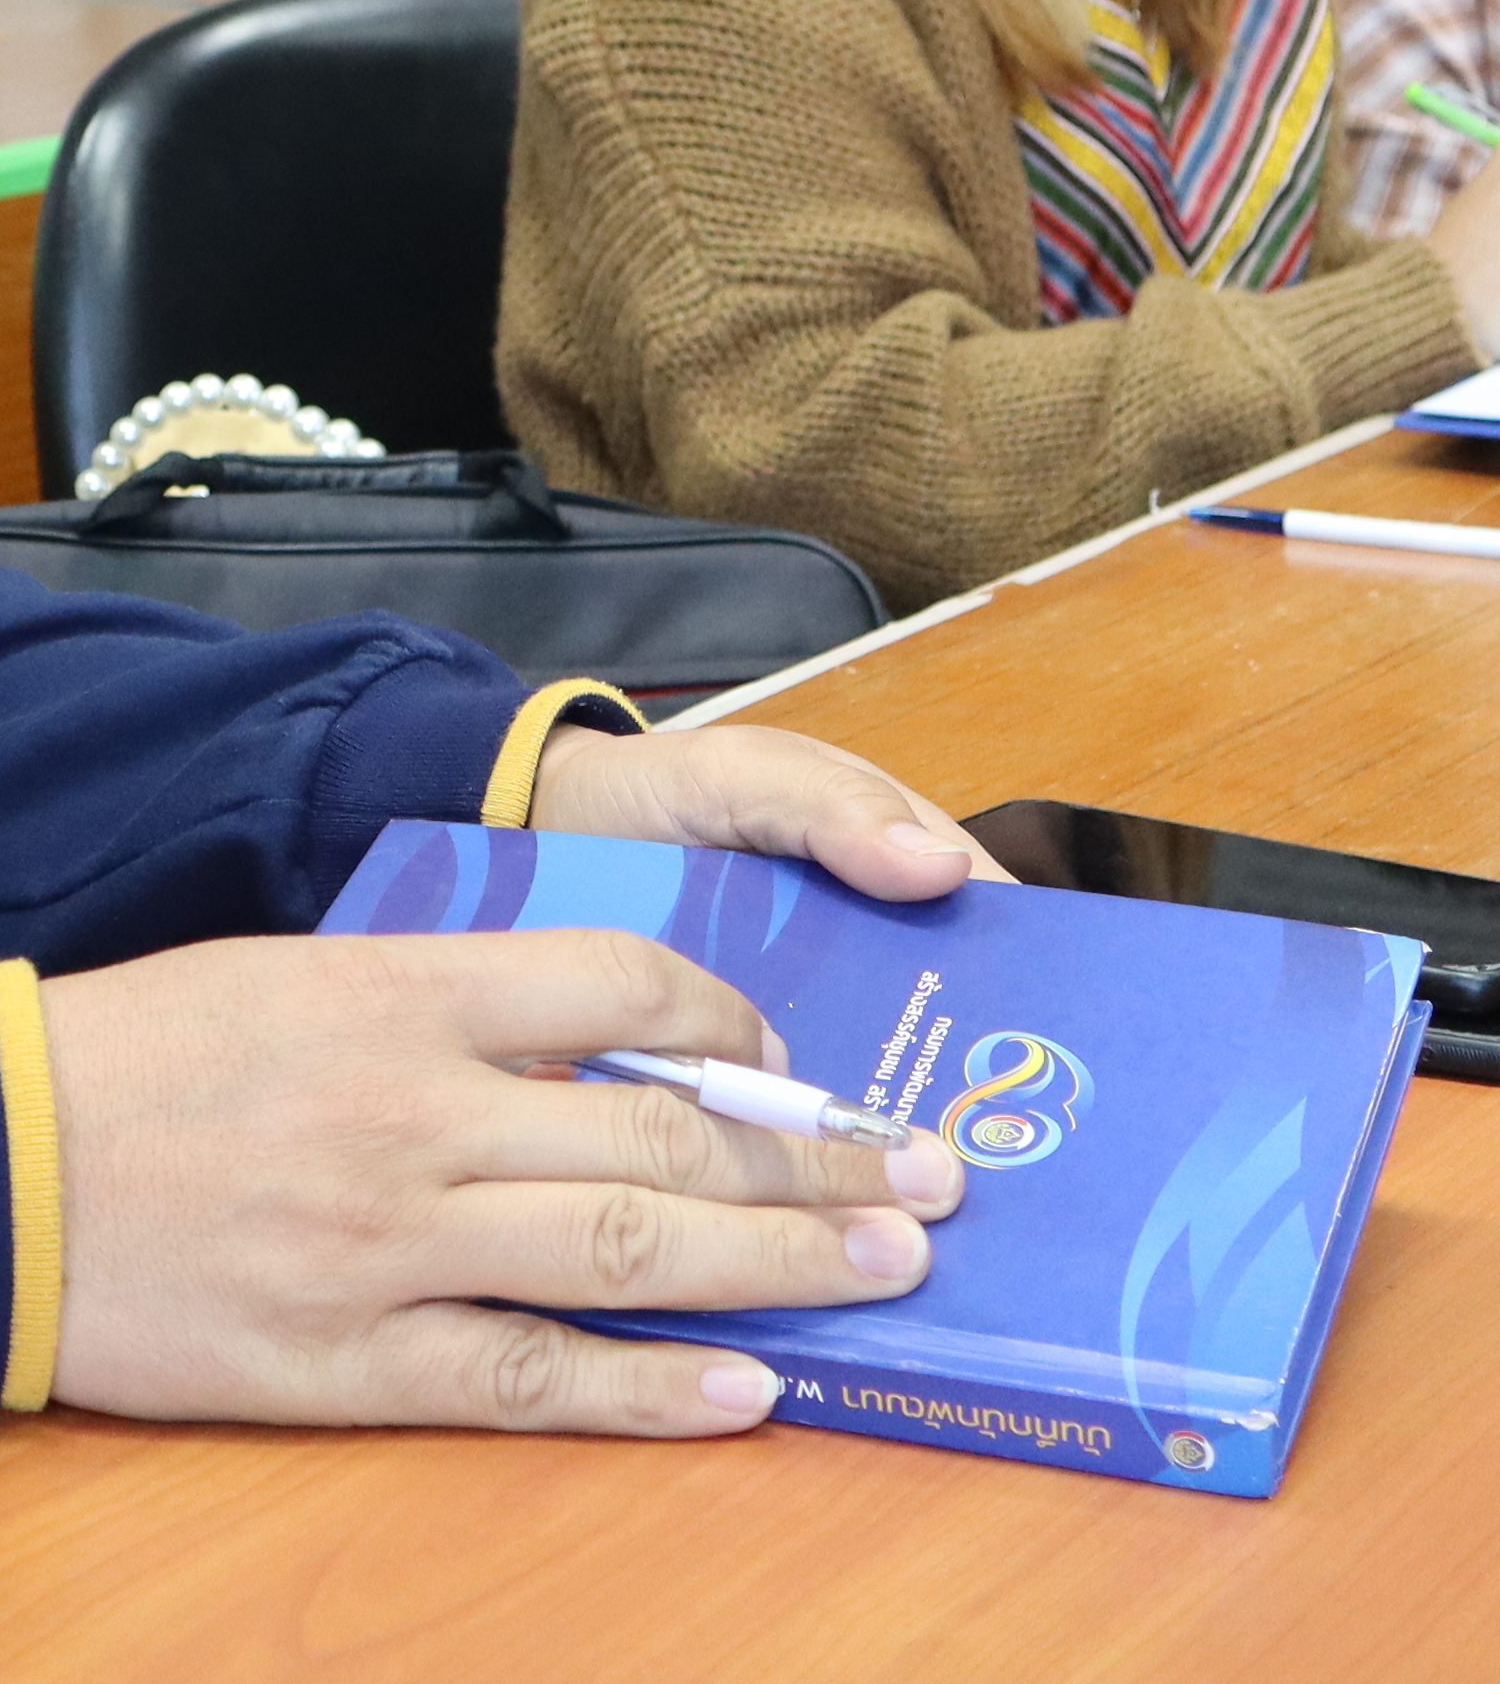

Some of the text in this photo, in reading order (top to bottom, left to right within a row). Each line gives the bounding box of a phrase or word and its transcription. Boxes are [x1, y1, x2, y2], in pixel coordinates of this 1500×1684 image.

[874, 970, 943, 1080] สร้างสรรค์ชุมชน
[890, 1016, 953, 1126] กรมการพัฒนาช
[840, 1385, 1112, 1456] บันทึกนักพัฒนา
